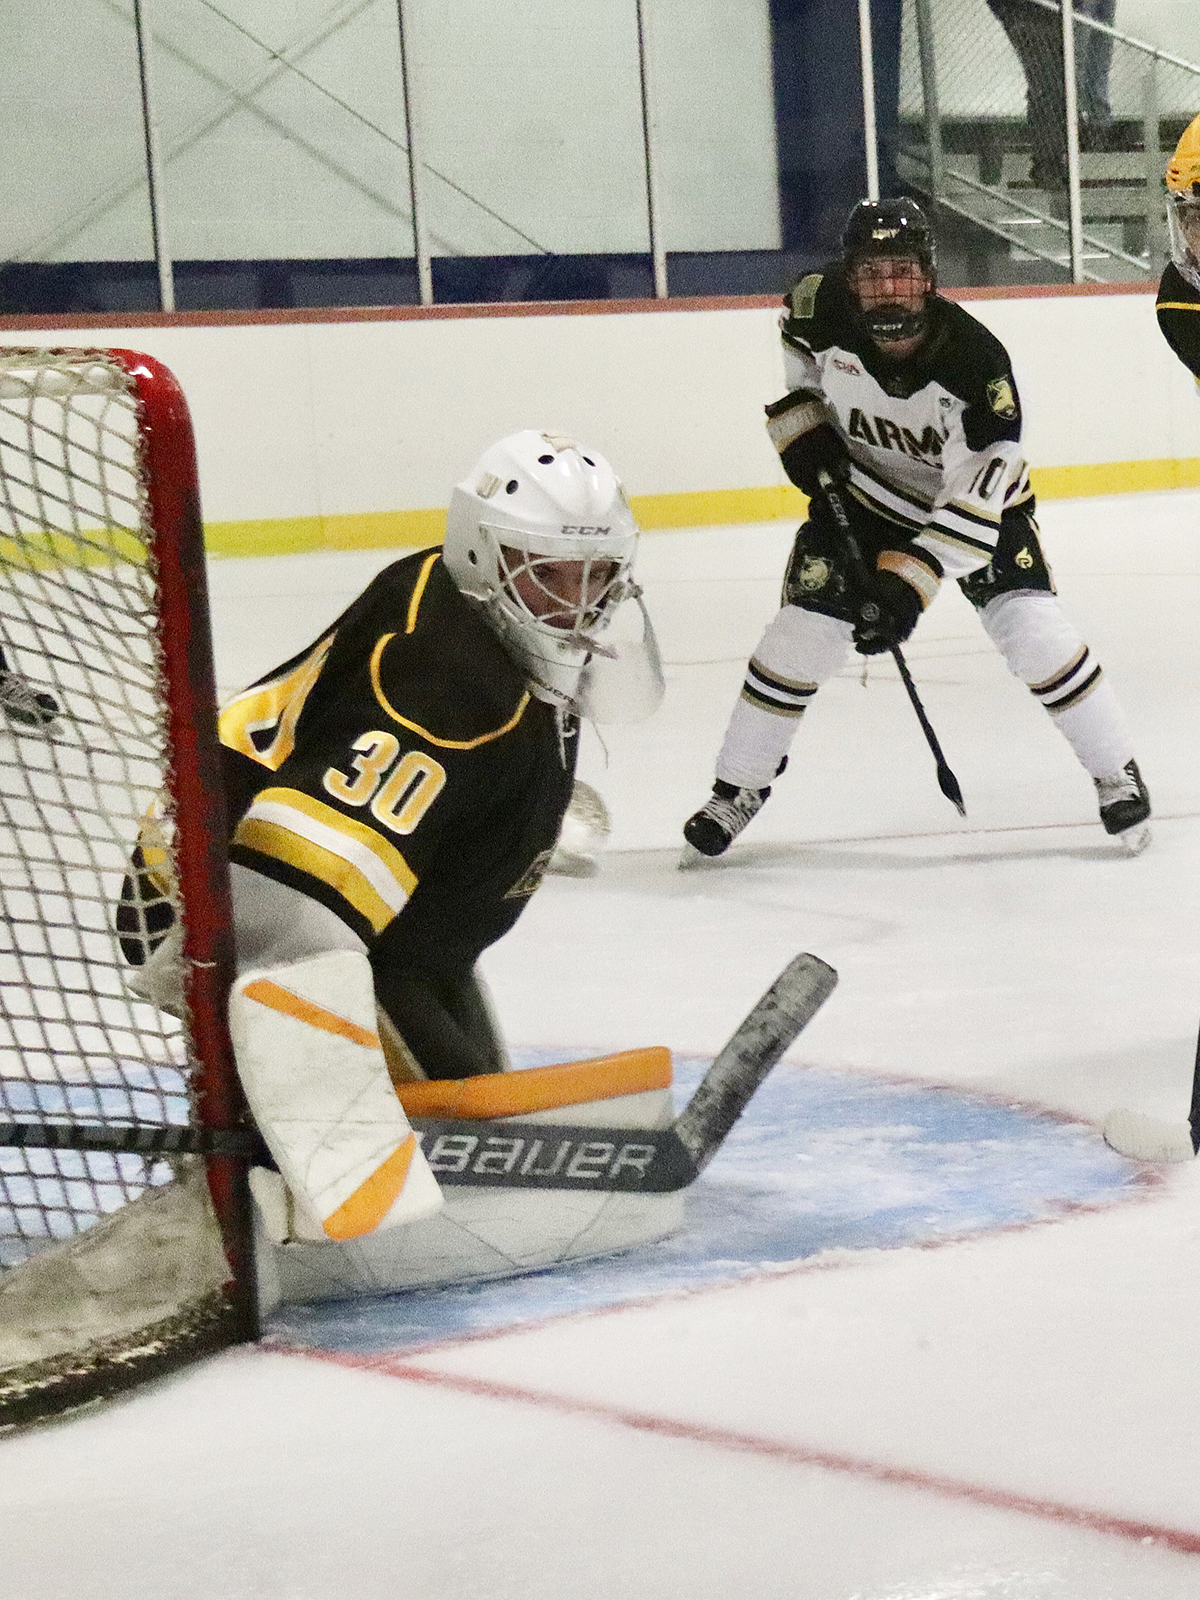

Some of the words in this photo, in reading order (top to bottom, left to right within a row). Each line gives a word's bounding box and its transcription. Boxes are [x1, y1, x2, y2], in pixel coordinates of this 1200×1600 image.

[848, 407, 948, 456] ARM
[561, 525, 611, 535] CCM
[322, 730, 447, 836] 30
[427, 1133, 657, 1180] BAUER
